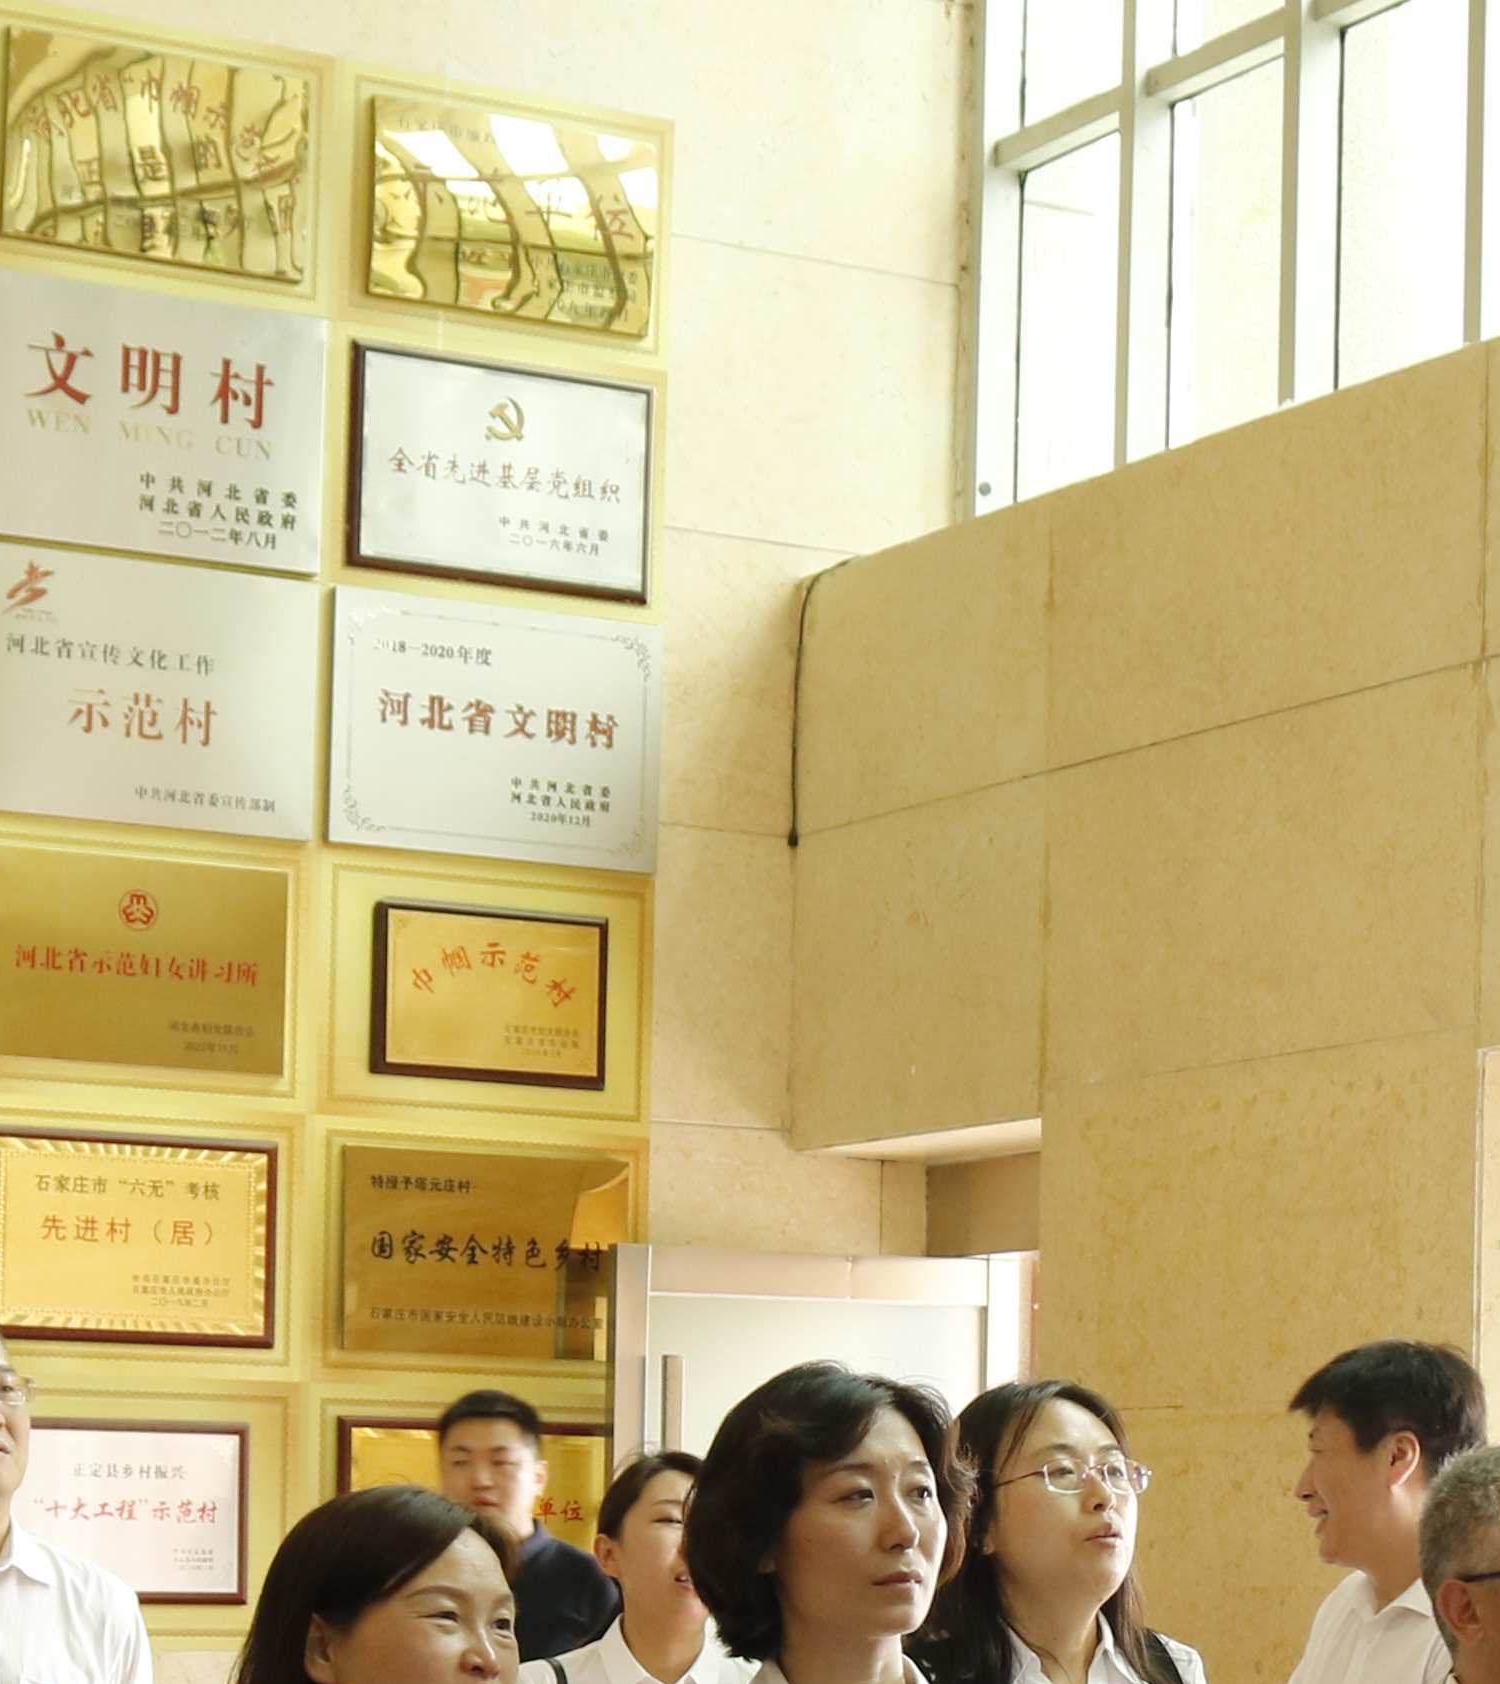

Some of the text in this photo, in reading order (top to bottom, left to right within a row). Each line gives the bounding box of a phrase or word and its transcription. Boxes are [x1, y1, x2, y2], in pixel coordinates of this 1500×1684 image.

[25, 331, 276, 431] 文明村
[25, 408, 92, 436] WEN
[214, 434, 273, 461] CUN
[139, 471, 299, 510] 中共河北省委
[389, 446, 623, 505] 全省先进基层党组织
[138, 493, 298, 532] 河北省人民政府
[499, 514, 609, 543] 中共河北省委
[158, 519, 278, 551] 二〇一二年八月
[5, 632, 215, 677] 河北省宣传文化工作
[66, 688, 218, 748] 示范村
[378, 688, 619, 750] 河北省文明村
[510, 776, 611, 800] 中共河北省委
[510, 791, 611, 814] 河北省人民政府
[15, 944, 258, 987] 河北省示范妇女讲习所
[370, 1229, 603, 1273] 国家安全特色乡村
